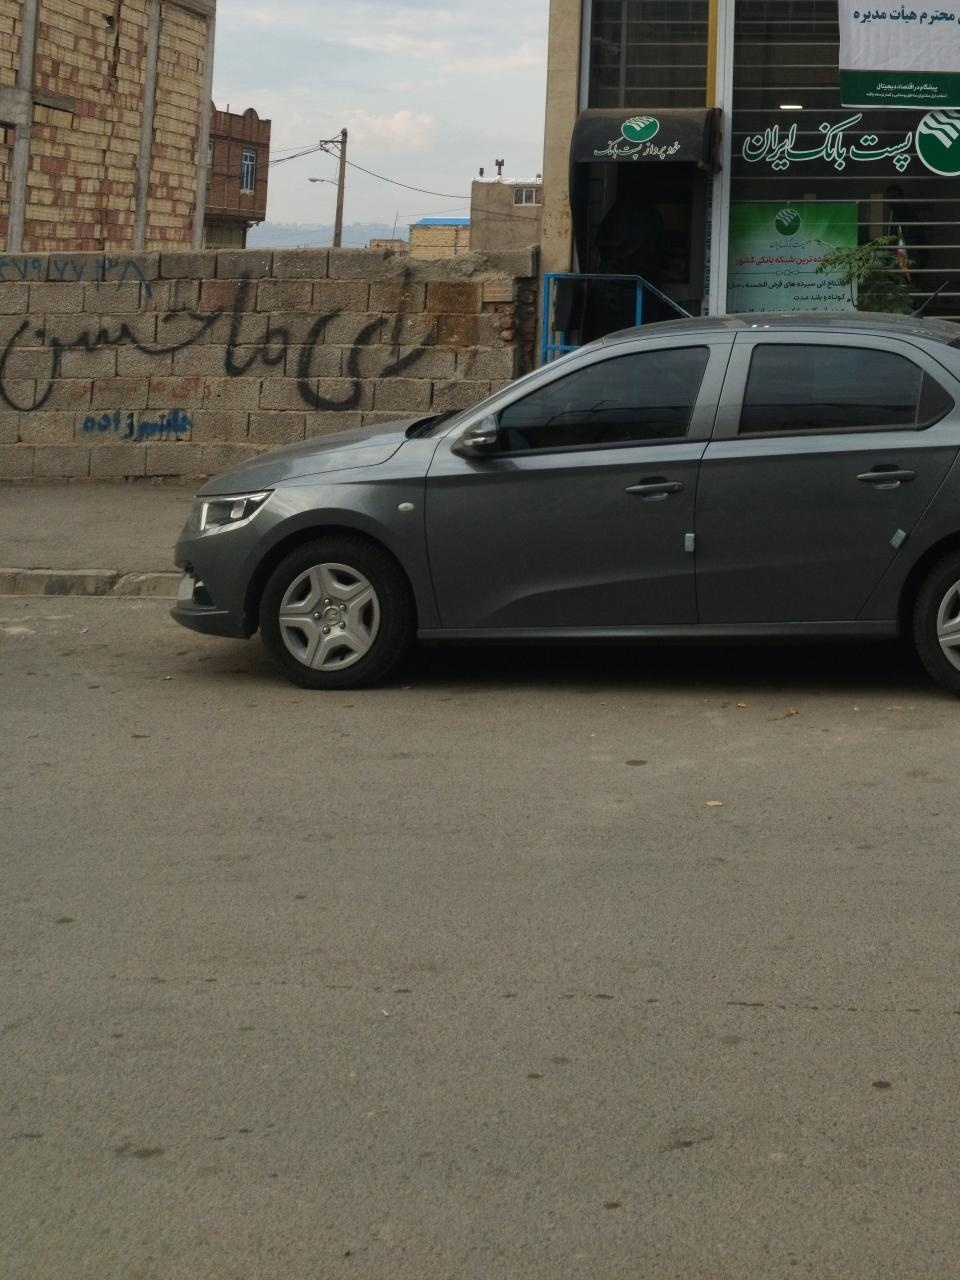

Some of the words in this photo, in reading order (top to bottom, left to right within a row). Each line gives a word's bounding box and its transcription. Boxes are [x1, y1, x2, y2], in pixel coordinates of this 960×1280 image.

[852, 8, 887, 25] مدیره
[919, 9, 956, 27] محترم
[618, 143, 643, 160] پست
[742, 122, 798, 171] ایران
[785, 112, 863, 171] بانک
[849, 131, 914, 173] پست
